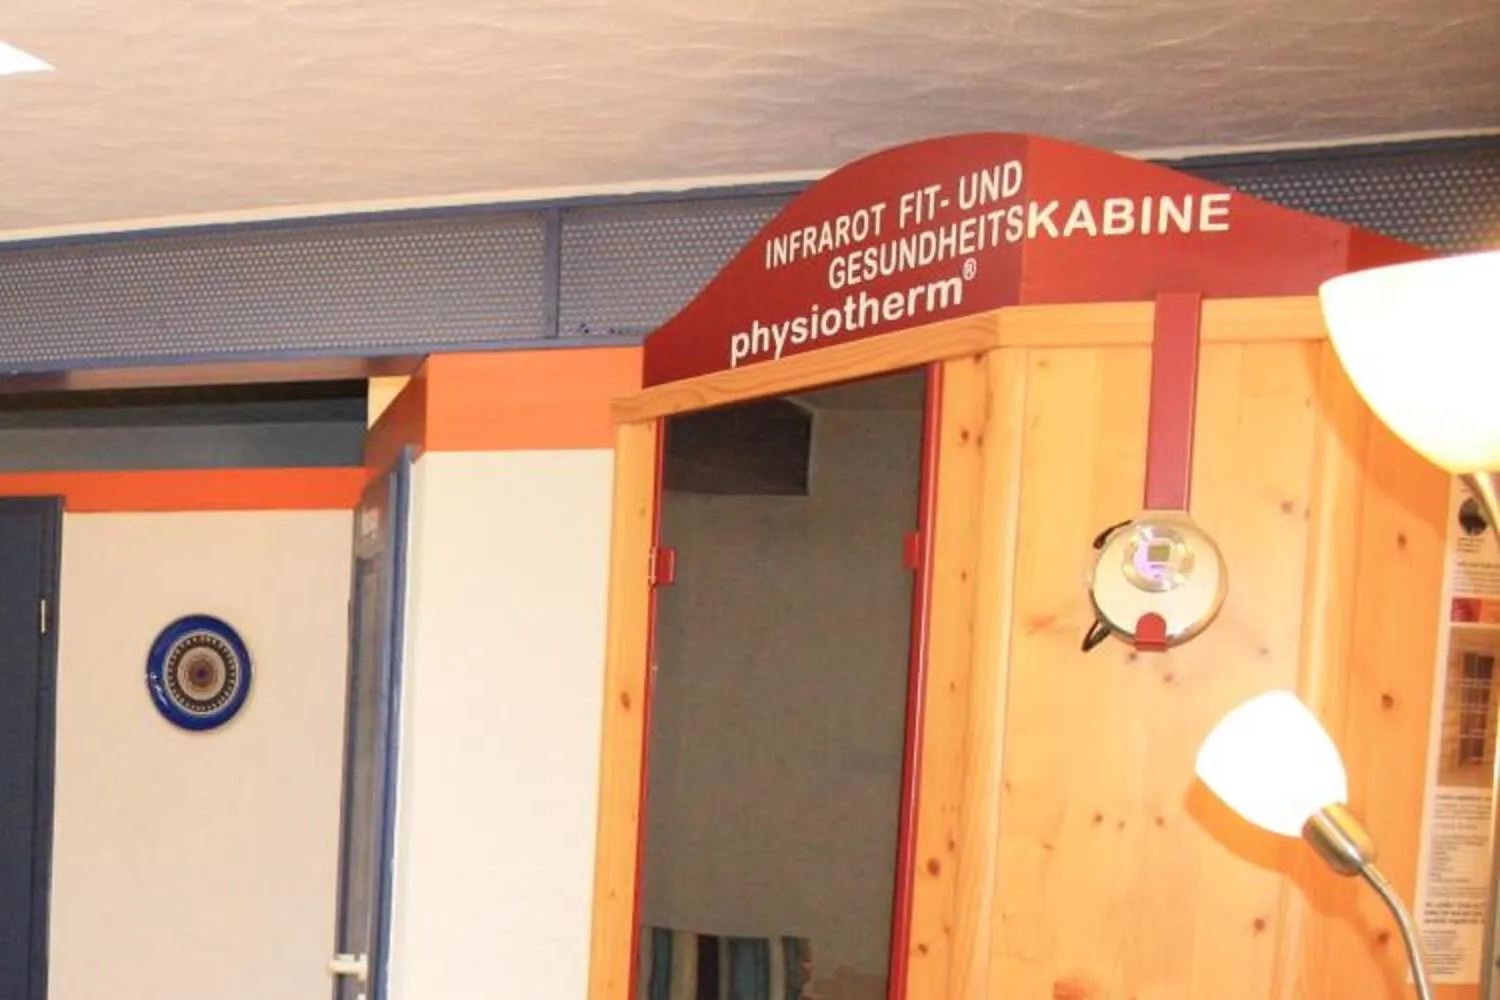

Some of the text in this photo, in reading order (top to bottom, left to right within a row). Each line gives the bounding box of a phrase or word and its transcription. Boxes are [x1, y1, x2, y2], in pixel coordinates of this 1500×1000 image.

[764, 159, 1024, 270] INFRAROT FIT- UND
